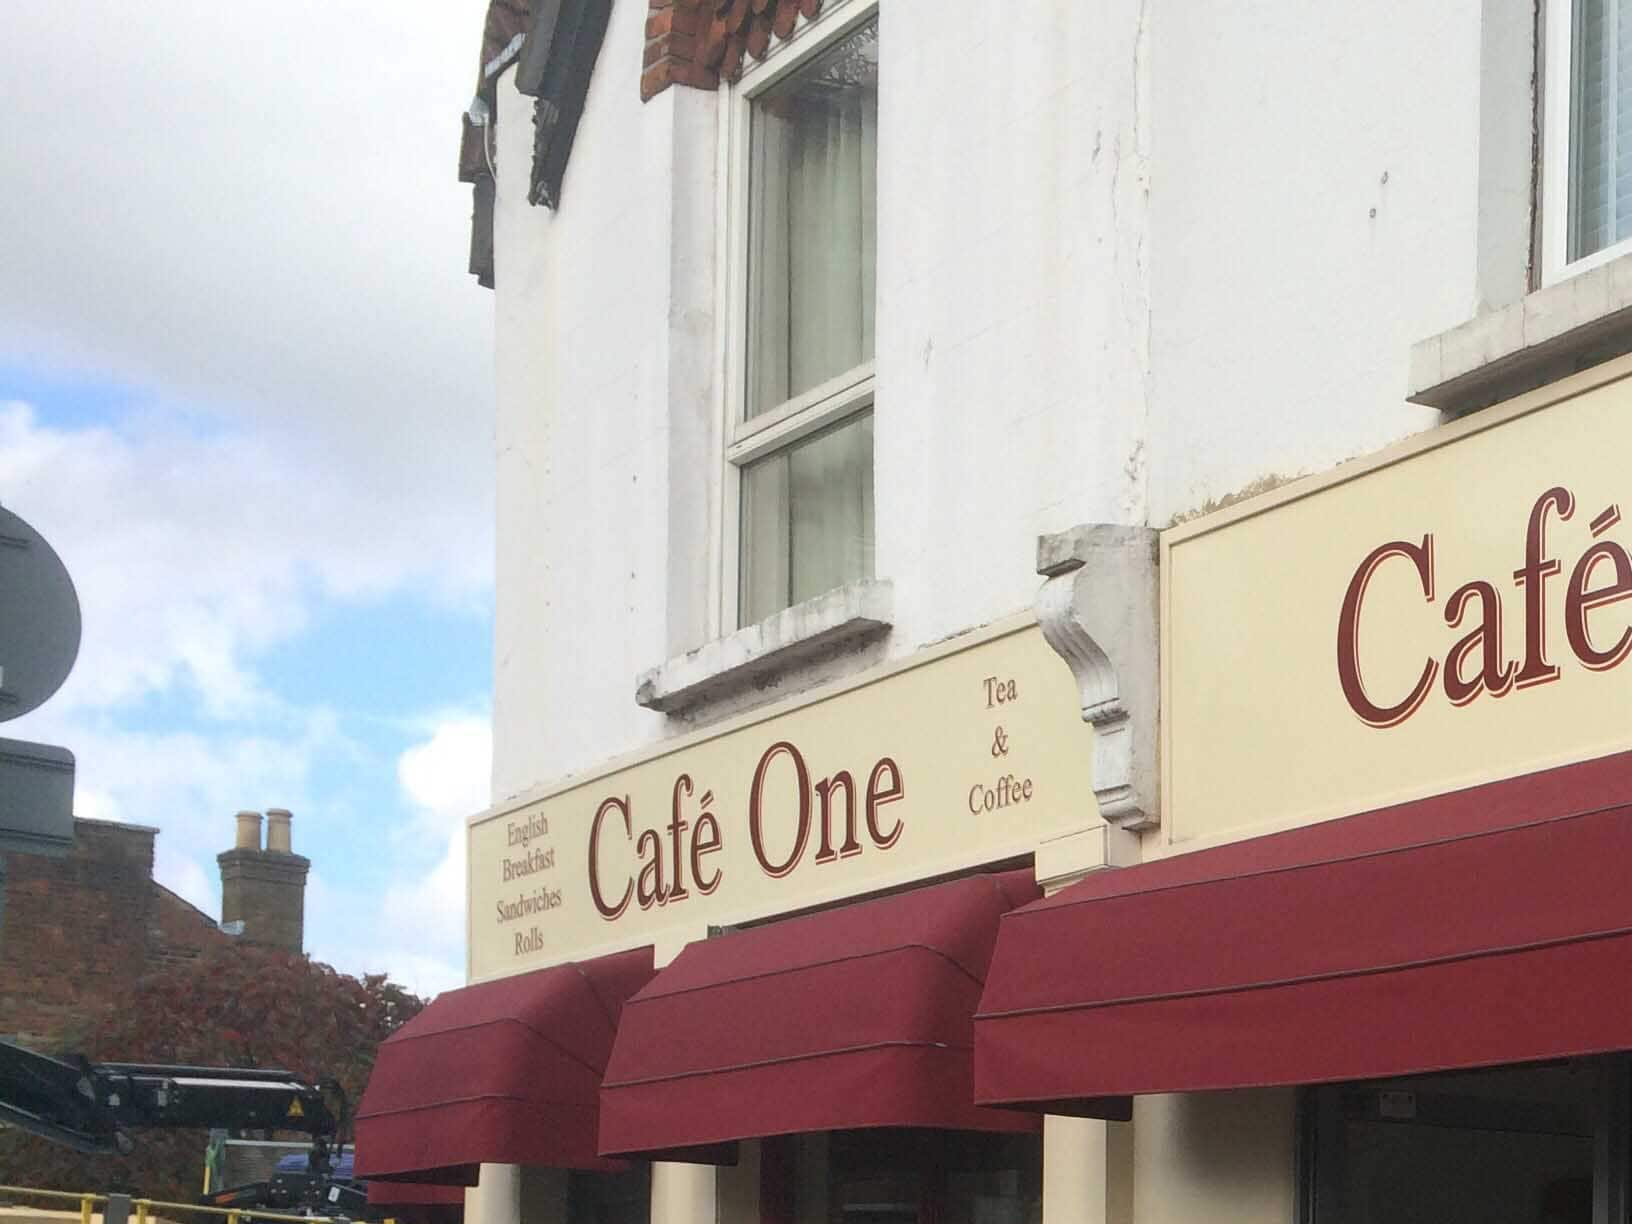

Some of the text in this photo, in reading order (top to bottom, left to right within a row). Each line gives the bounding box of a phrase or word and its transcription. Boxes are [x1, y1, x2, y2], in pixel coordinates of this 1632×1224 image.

[984, 677, 1017, 708] Tea
[992, 726, 1008, 758] &
[969, 774, 1032, 815] Coffee
[506, 811, 548, 848] English
[588, 741, 905, 921] Café One
[503, 848, 554, 882] Breakfast
[497, 886, 562, 925] Sandwiches
[515, 927, 544, 955] Rolls
